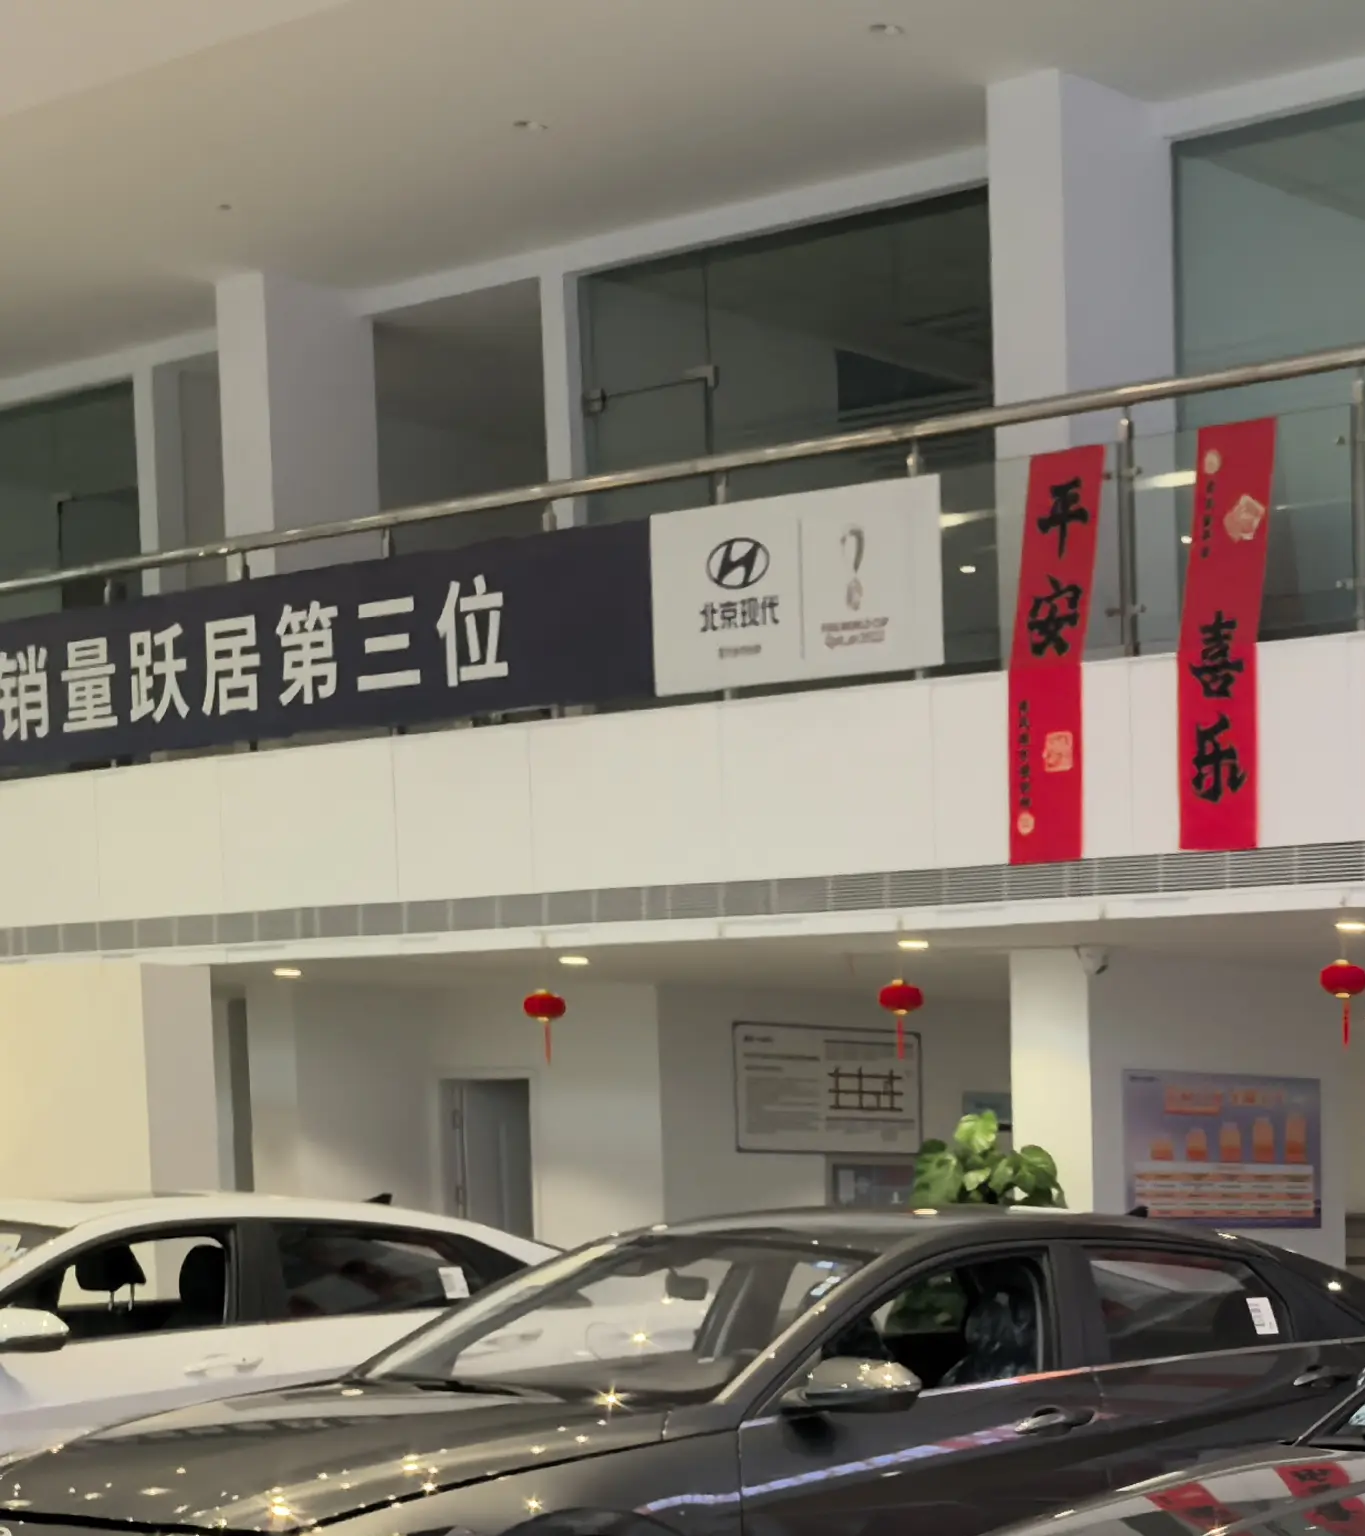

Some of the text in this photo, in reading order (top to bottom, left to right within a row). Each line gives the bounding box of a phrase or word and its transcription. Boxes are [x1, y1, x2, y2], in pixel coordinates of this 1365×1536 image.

[699, 595, 781, 632] 北京现代
[1027, 477, 1089, 657] 平安
[0, 574, 509, 741] 销量跃居第三位
[1189, 611, 1246, 803] 喜乐
